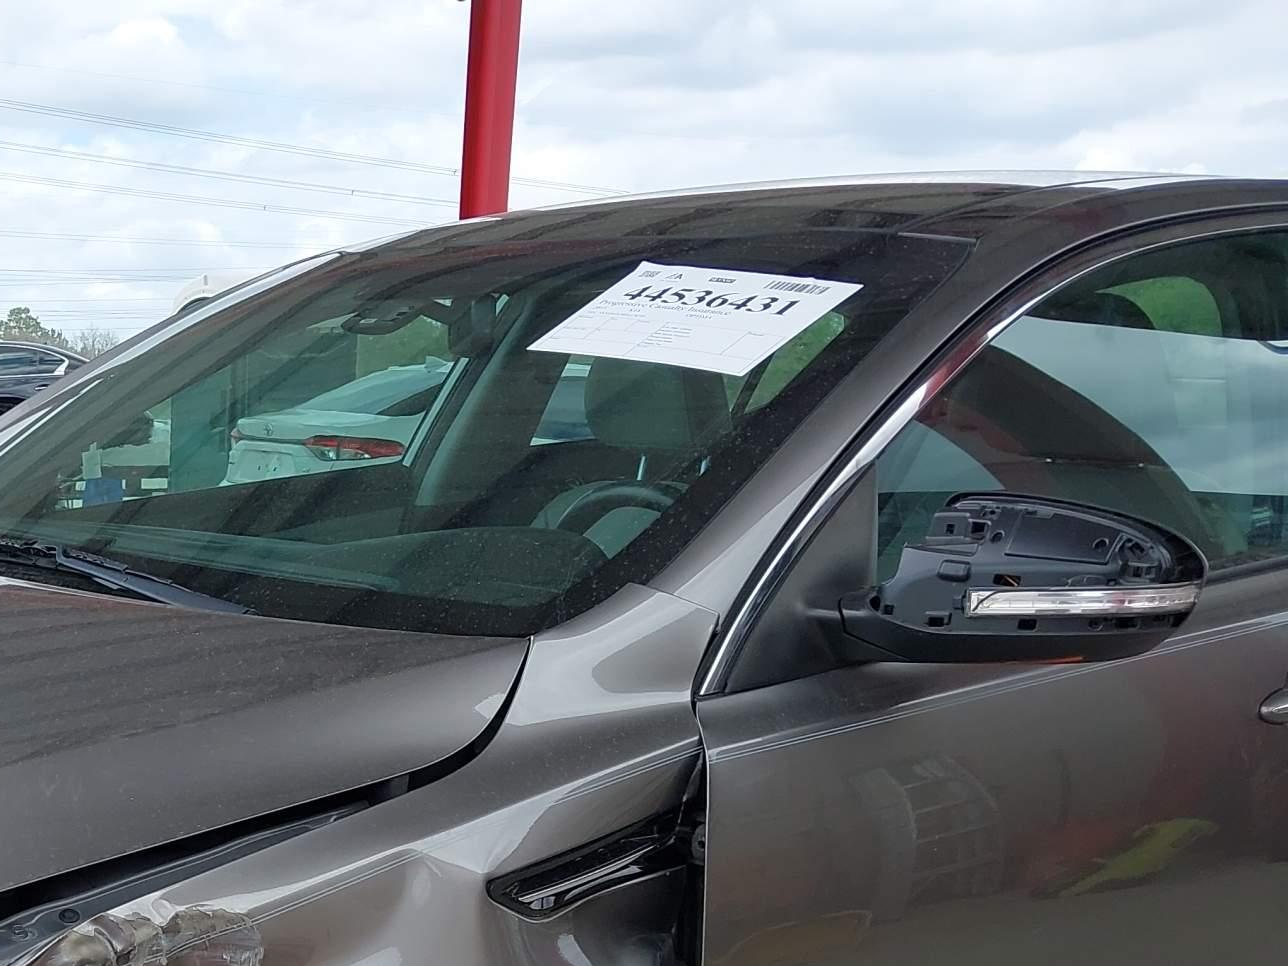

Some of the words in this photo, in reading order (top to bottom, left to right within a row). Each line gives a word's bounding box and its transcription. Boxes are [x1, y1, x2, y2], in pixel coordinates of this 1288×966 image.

[599, 299, 648, 310] Progressive
[648, 302, 686, 313] Casualty
[687, 306, 732, 316] Insurance
[623, 285, 801, 316] 44536431
